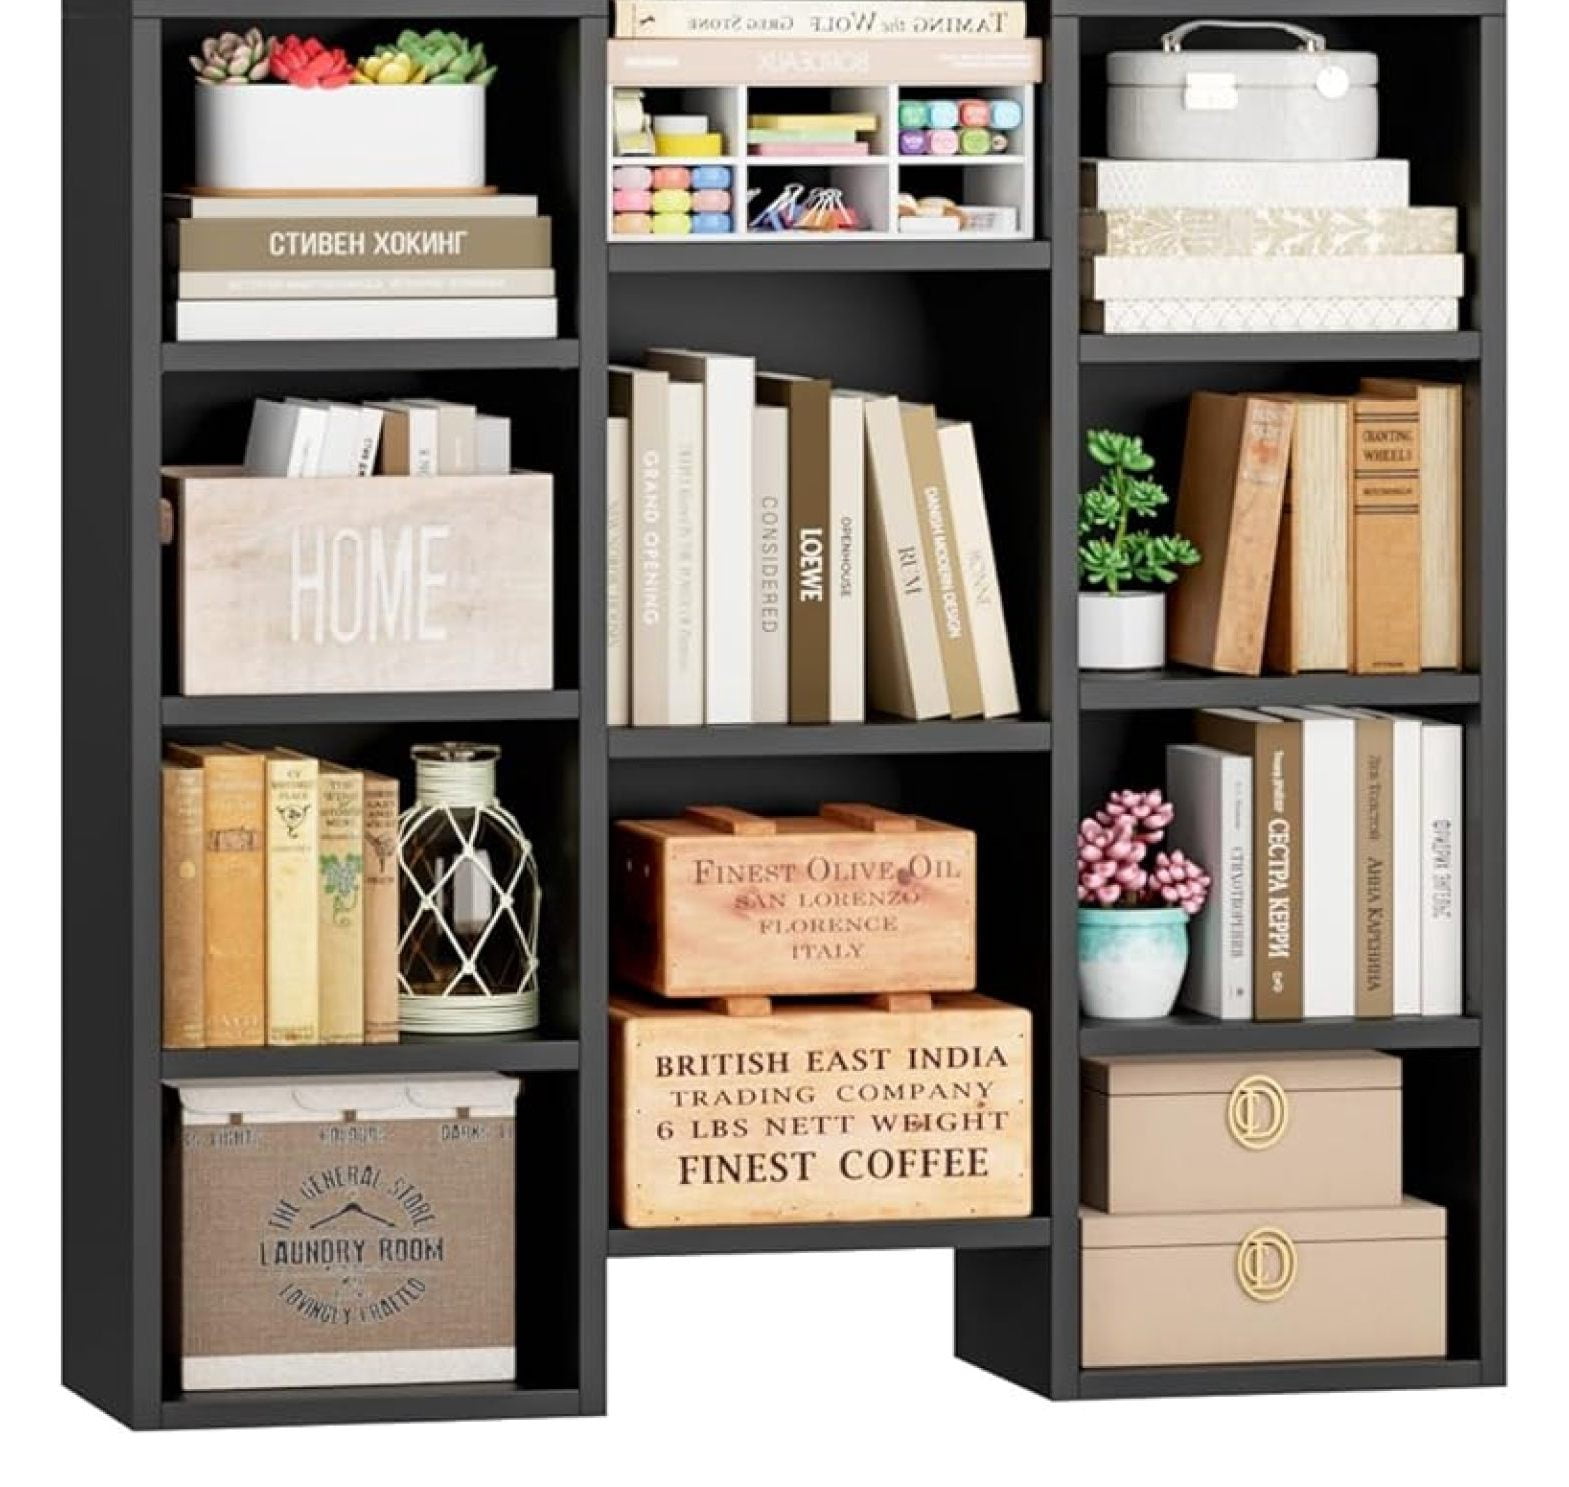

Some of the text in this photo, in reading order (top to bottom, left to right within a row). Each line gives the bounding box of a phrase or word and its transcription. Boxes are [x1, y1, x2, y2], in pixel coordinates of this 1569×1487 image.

[269, 230, 470, 257] СТИВЕН ХОКИНГ
[641, 448, 660, 626] GRAND OPENING
[760, 494, 779, 634] CONSIDERED
[799, 526, 823, 603] LOEWE
[289, 524, 452, 646] HOME
[693, 853, 961, 886] FINEST OLIVE OIL
[1267, 818, 1290, 896] СЕСТРА
[734, 888, 920, 909] SAN LORENZO
[758, 914, 899, 934] FLORENCE
[1267, 899, 1290, 960] КЕРРИ
[791, 943, 866, 961] ITALY
[655, 1045, 1009, 1079] BRITISH EAST INDIA
[669, 1080, 996, 1109] TRADING COMPANY
[656, 1110, 1010, 1141] 6 LBS NETT WEIGHT
[678, 1147, 990, 1185] FINEST COFFEE
[267, 1164, 438, 1232] THE GENERAL STORE
[258, 1236, 445, 1267] LAUNDRY ROOM
[278, 1281, 352, 1325] LOVINGLY
